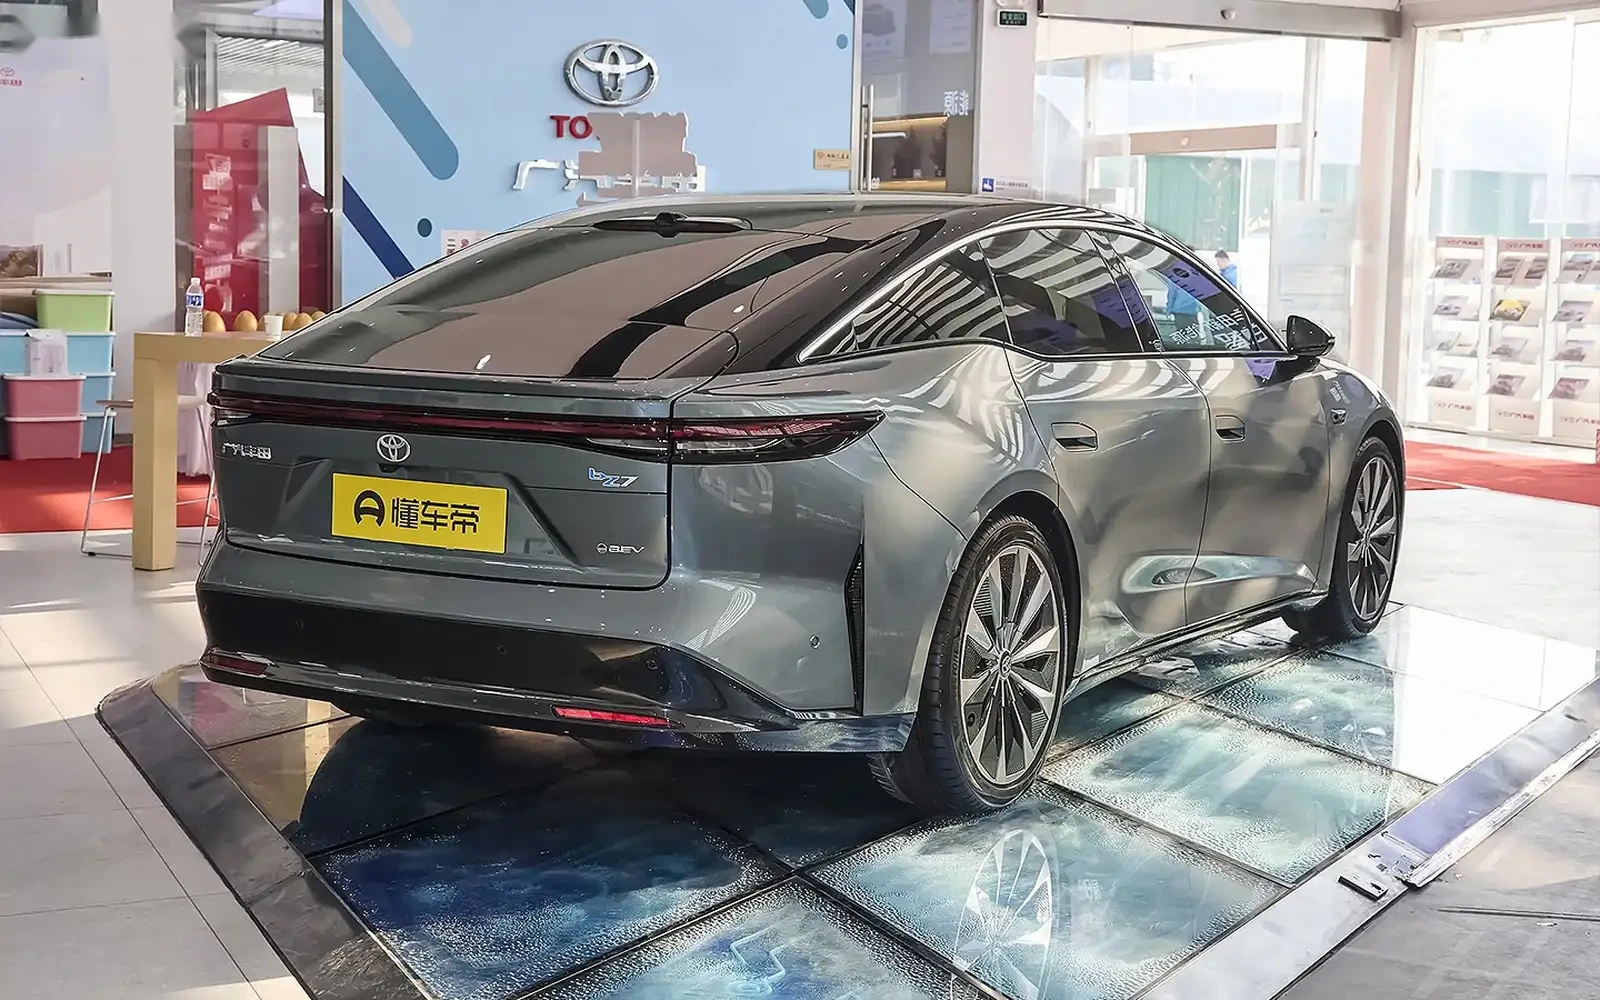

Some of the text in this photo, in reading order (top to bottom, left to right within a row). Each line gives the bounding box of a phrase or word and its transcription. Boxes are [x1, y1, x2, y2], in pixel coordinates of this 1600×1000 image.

[223, 442, 271, 460] 广汽丰田
[391, 498, 480, 534] 懂车帝
